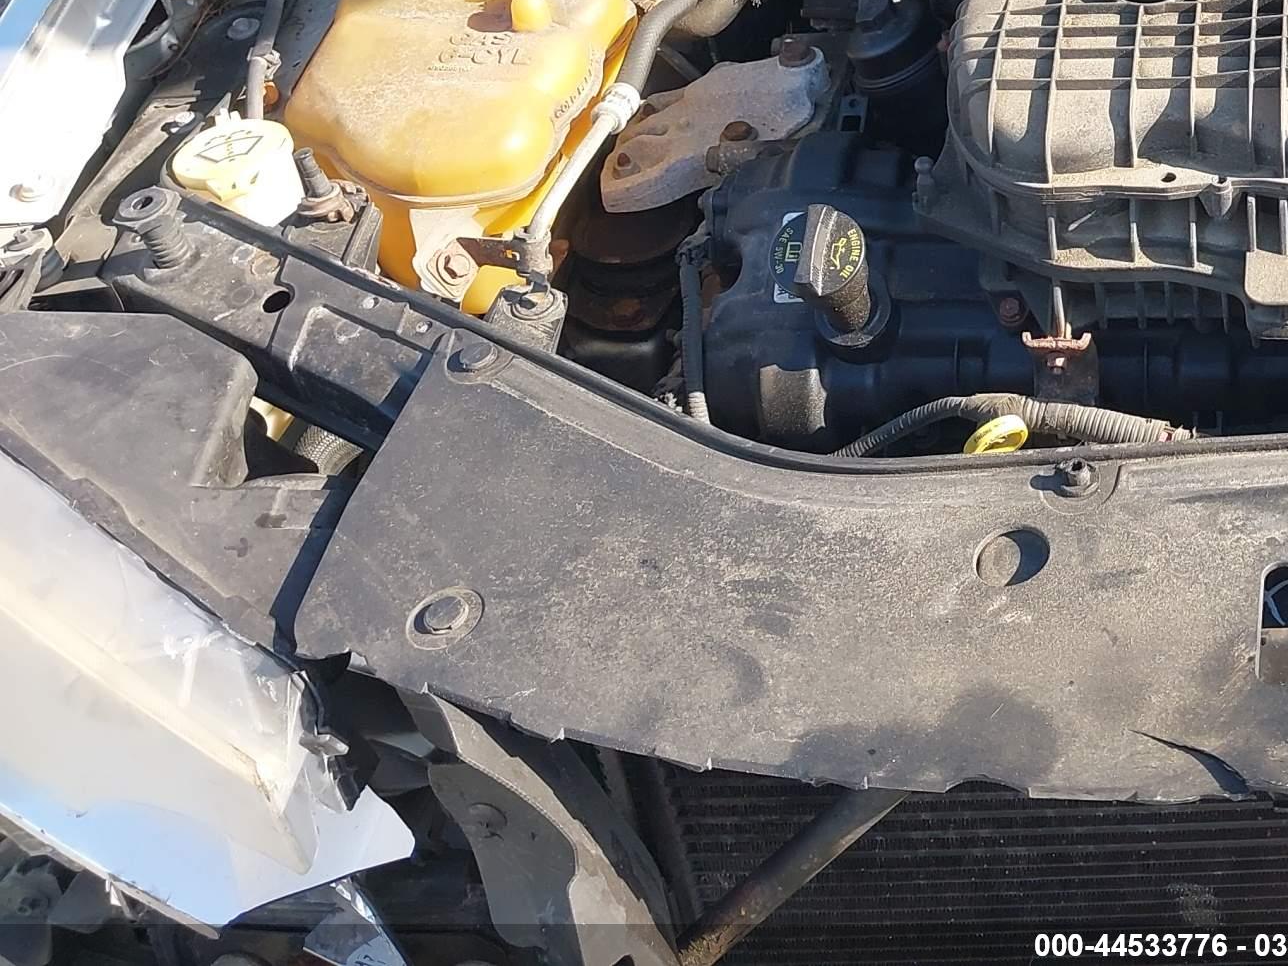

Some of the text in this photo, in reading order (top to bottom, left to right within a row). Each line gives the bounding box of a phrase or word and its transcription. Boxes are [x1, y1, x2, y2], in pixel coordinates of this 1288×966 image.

[449, 33, 513, 46] GAS
[438, 48, 531, 65] 6-CYL
[773, 228, 793, 274] SAE 5W-30
[839, 228, 861, 279] ENGINE OIL
